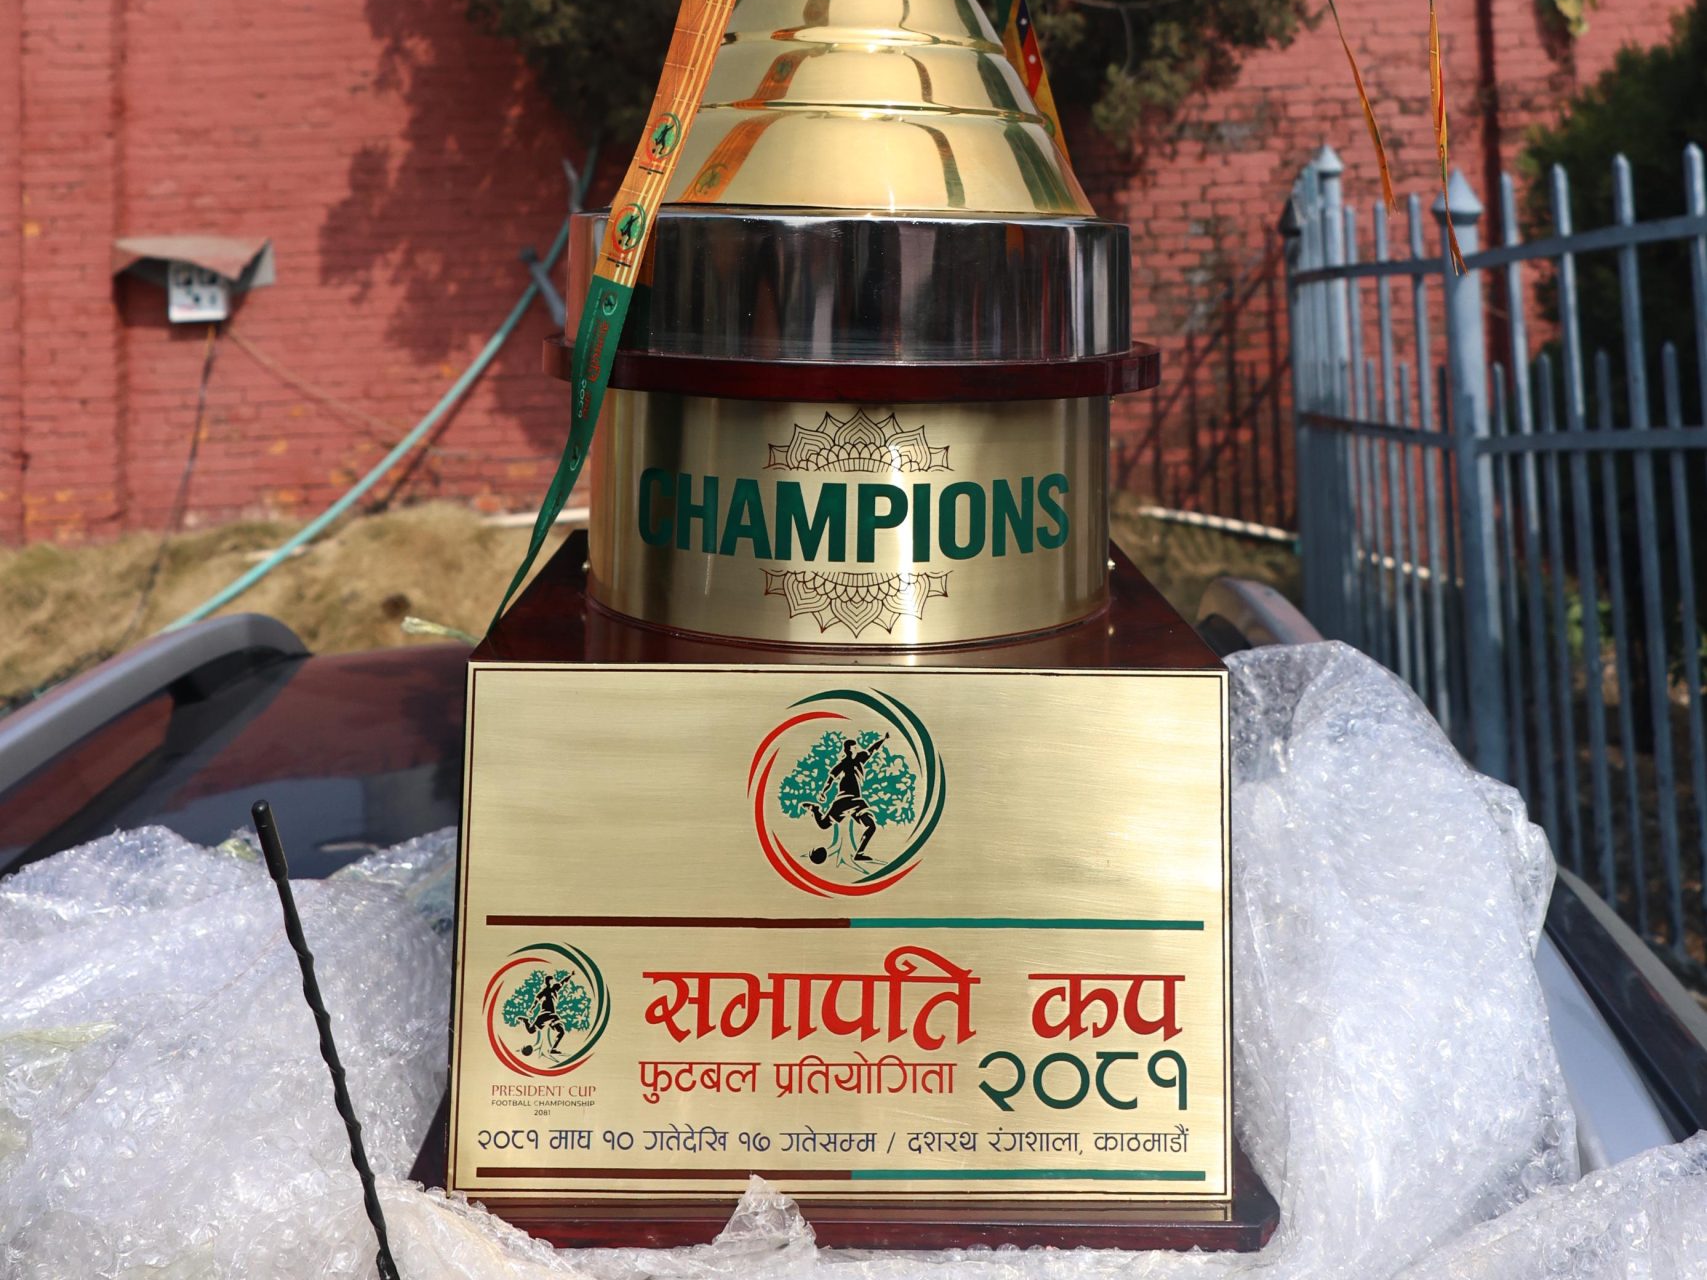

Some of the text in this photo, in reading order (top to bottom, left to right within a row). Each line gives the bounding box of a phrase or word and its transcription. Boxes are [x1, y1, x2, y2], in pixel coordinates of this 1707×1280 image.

[638, 468, 1070, 563] CHAMPIONS
[642, 946, 1186, 1051] सभापति कप
[491, 1084, 597, 1098] PRESIDENT CUP
[491, 1099, 596, 1108] FOOTBALL CHAMPIONSHIP
[638, 1051, 958, 1104] फुटबल प्रतियोगिता
[977, 1049, 1188, 1112] २०८१
[477, 1129, 539, 1150] २०८१
[549, 1129, 593, 1151] माघ
[602, 1131, 635, 1151] १०
[643, 1123, 729, 1153] गतेदेखि
[738, 1131, 771, 1153] १७
[779, 1124, 878, 1153] गतेसम्म
[886, 1131, 897, 1154] /
[906, 1131, 979, 1154] दशरथ
